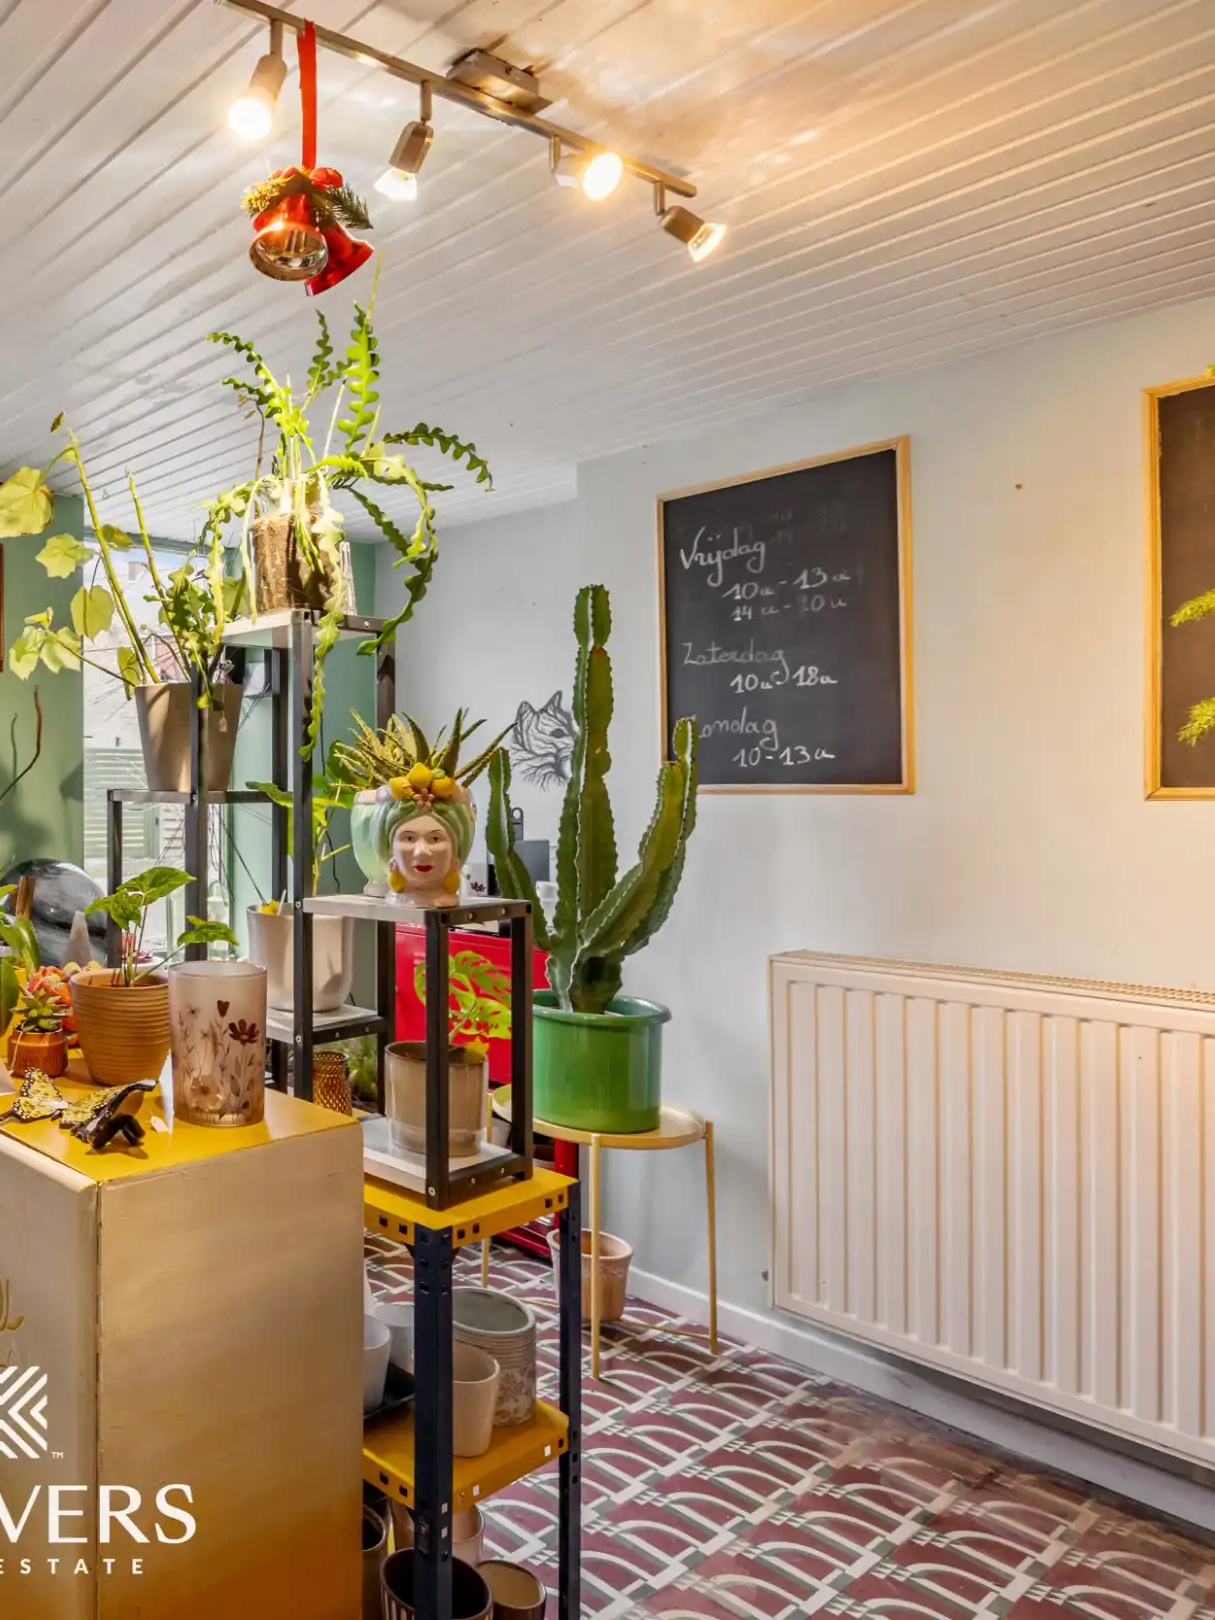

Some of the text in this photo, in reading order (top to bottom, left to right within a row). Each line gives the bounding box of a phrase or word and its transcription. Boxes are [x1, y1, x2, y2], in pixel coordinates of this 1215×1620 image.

[680, 526, 766, 587] Vrijdag
[682, 637, 790, 684] Zaterdag
[686, 706, 780, 751] ondag
